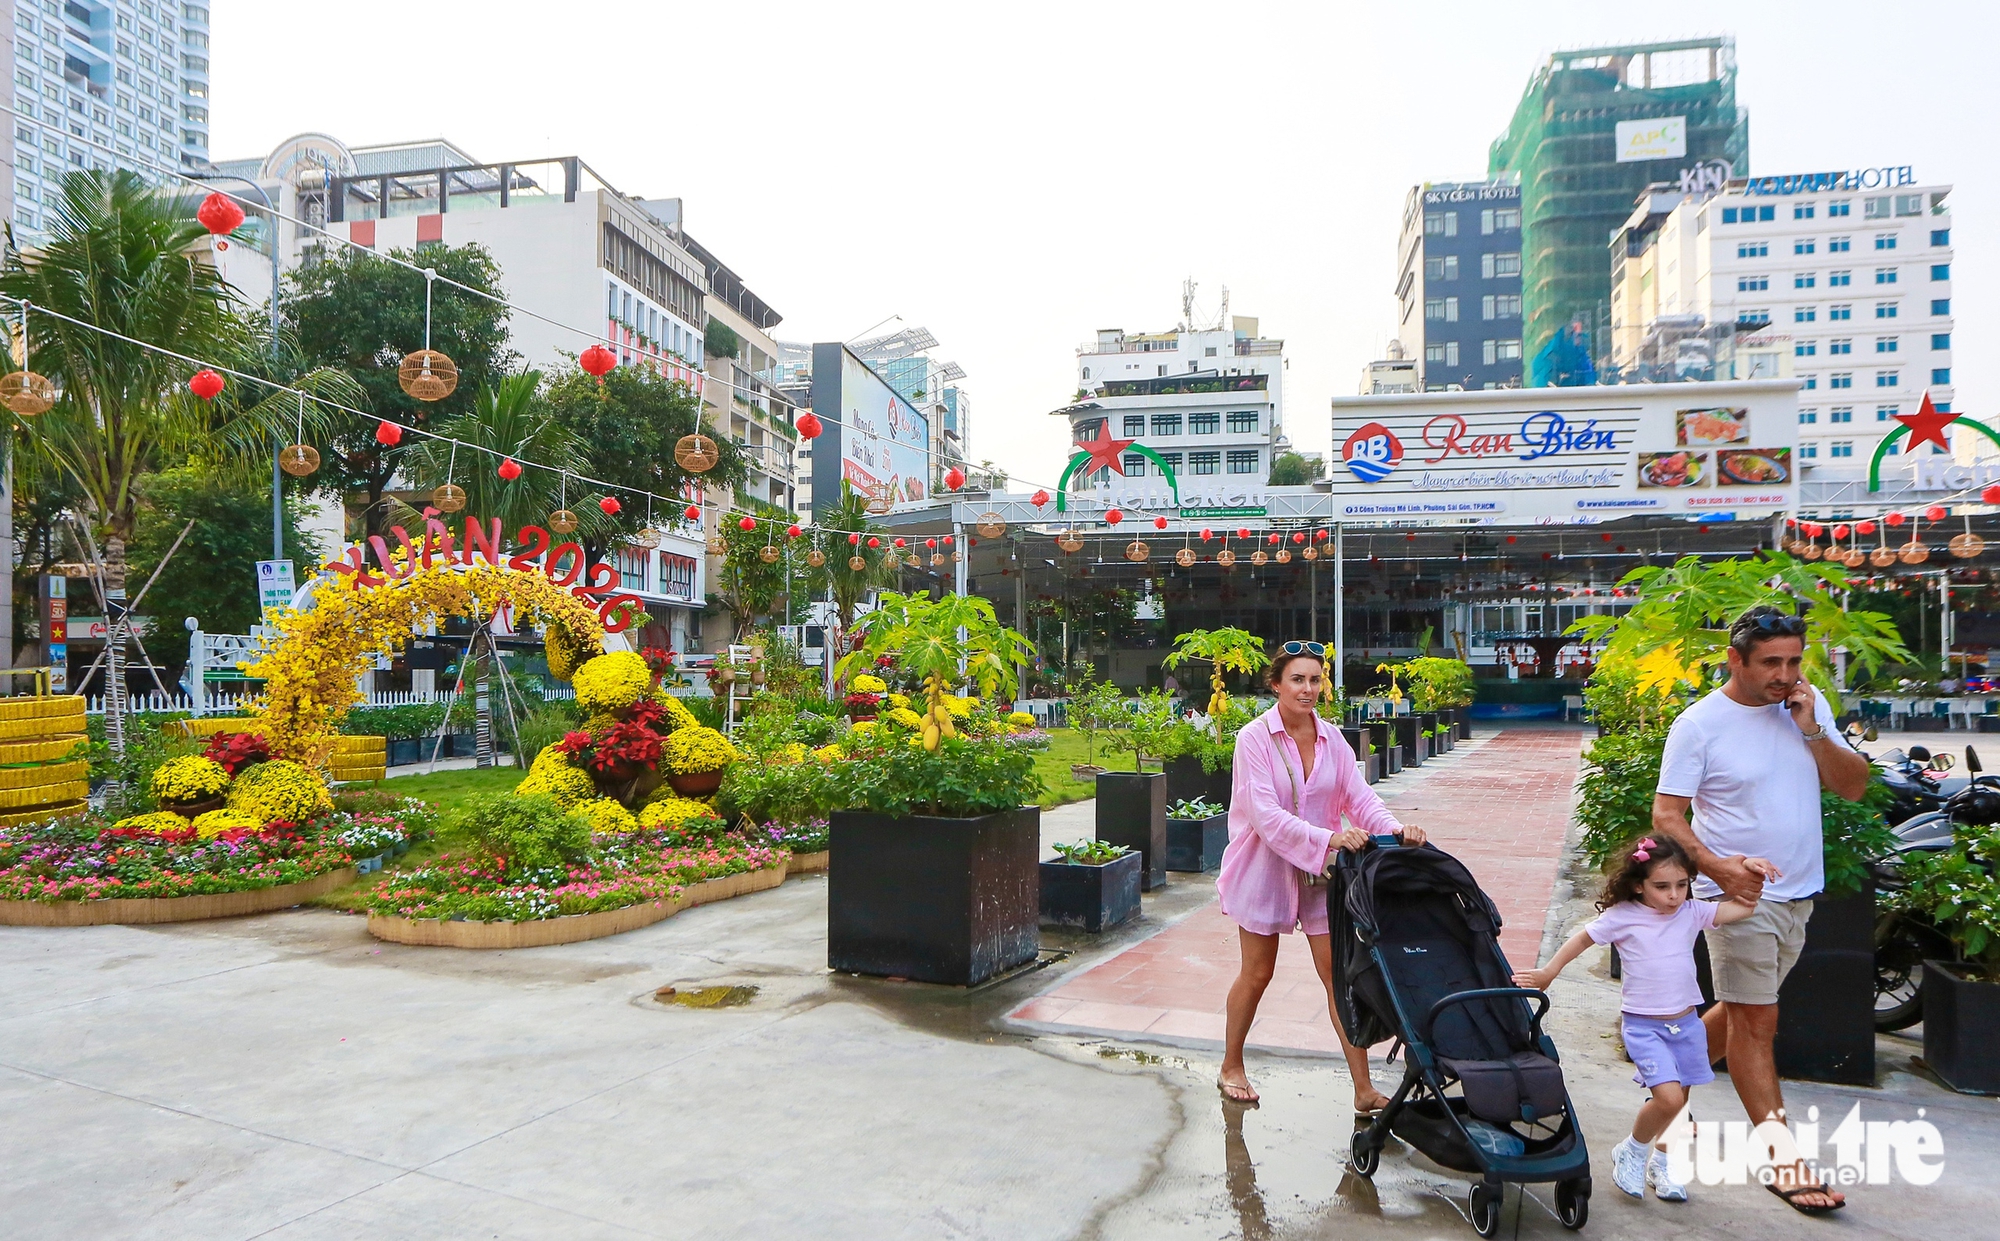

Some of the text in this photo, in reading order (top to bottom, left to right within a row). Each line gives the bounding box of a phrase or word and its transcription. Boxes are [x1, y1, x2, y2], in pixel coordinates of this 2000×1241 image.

[1844, 165, 1918, 191] HOTEL
[1479, 186, 1520, 201] HOTEL
[1351, 434, 1391, 463] RB
[1421, 411, 1617, 464] Rạn Biển
[1093, 474, 1270, 511] Heineken
[1412, 470, 1450, 491] Mang
[326, 506, 646, 634] XUÂN 2026
